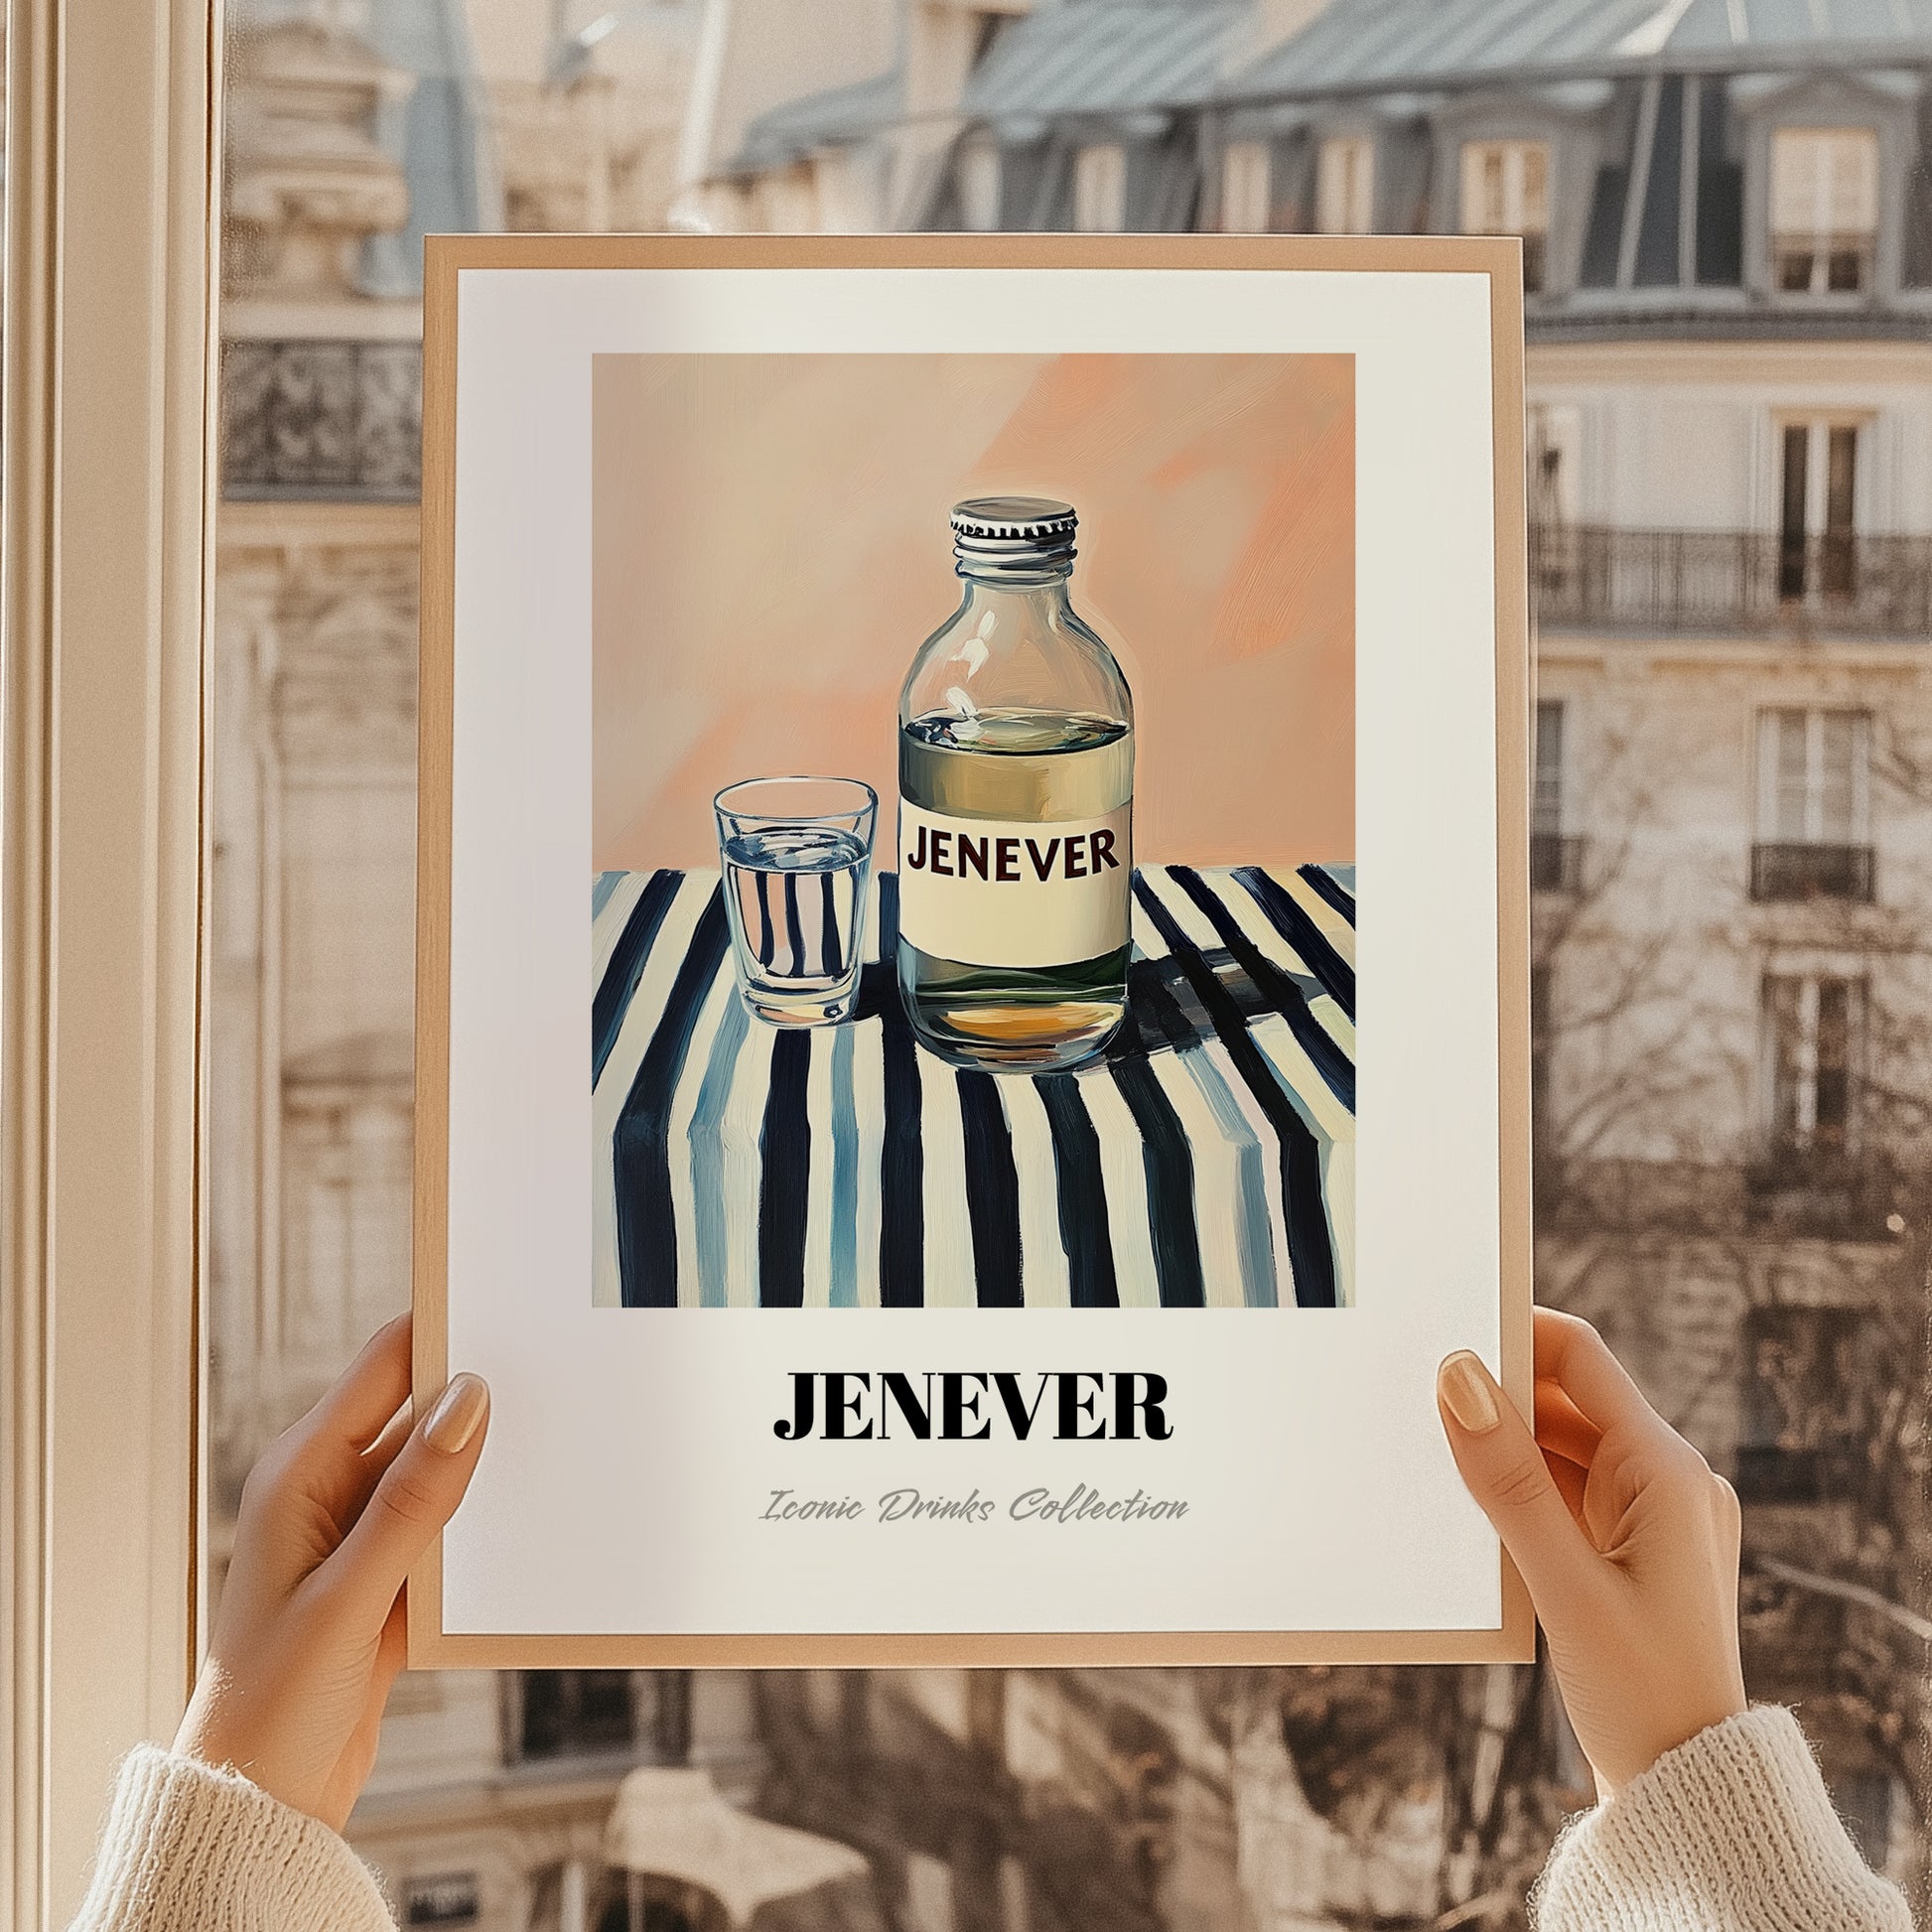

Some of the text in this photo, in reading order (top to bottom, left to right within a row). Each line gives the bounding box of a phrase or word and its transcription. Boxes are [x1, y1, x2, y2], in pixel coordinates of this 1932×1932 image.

[907, 825, 1121, 882] JENEVER
[772, 1372, 1174, 1441] JENEVER
[758, 1482, 1190, 1524] Iconic Drinks Collection
